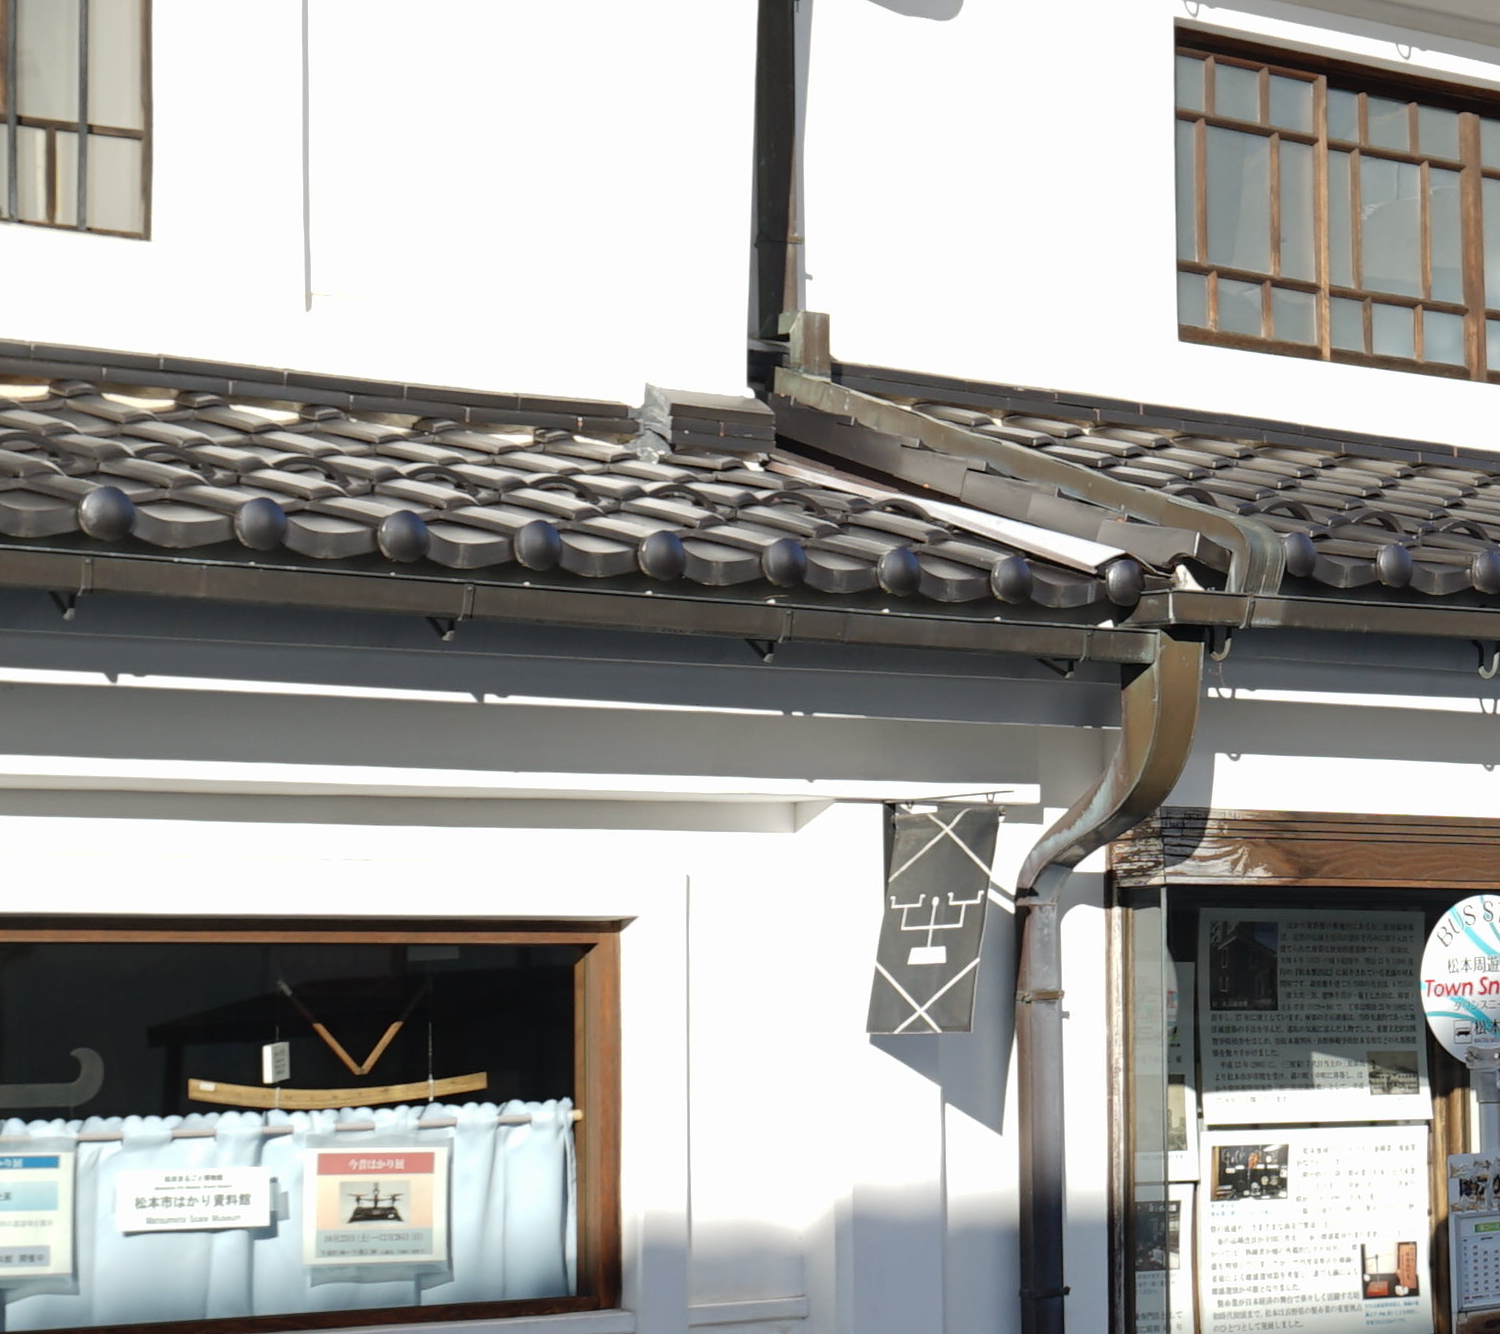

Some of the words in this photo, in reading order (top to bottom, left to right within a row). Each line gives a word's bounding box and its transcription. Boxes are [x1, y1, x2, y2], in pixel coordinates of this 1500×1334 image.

[1437, 905, 1476, 947] BUS
[1425, 979, 1473, 997] Town
[135, 1193, 251, 1210] 松本市はかり資料館
